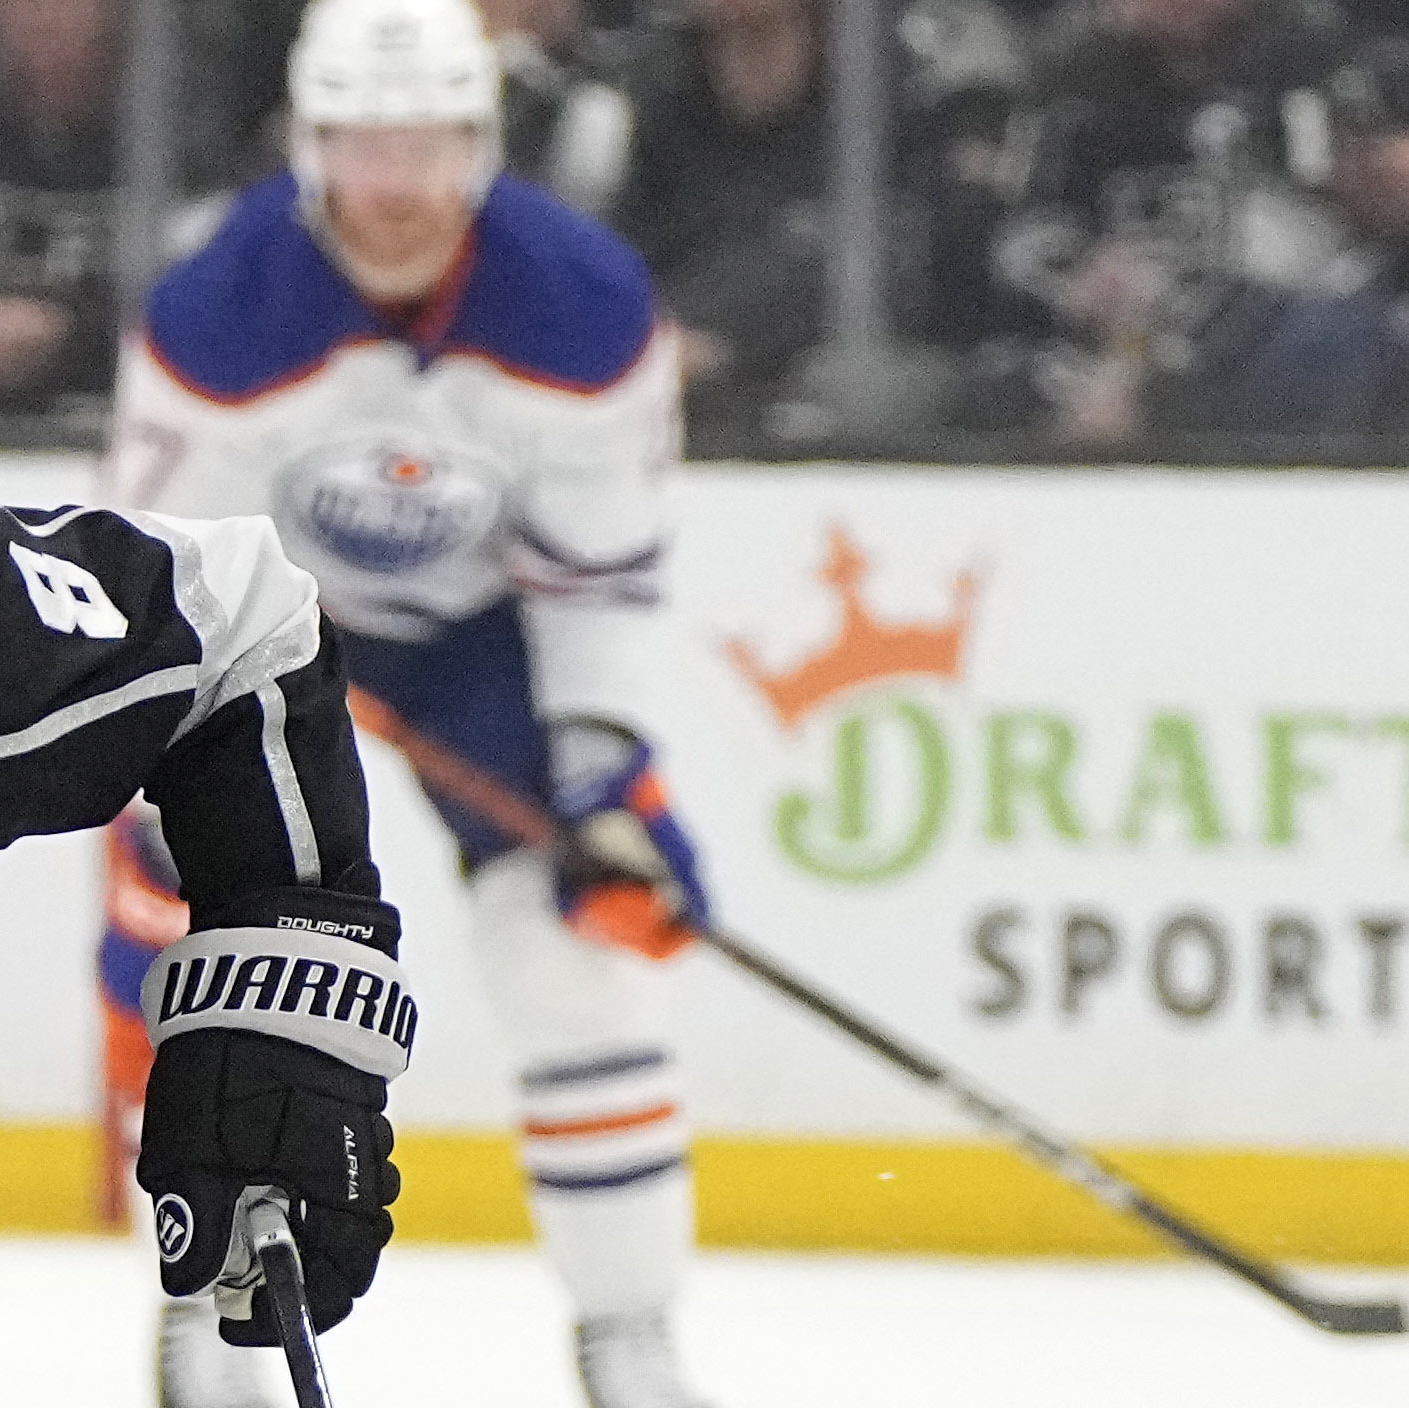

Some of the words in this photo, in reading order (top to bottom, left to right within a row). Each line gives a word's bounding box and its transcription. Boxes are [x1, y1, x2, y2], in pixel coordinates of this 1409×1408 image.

[8, 540, 129, 639] 8
[276, 905, 374, 940] DOUGHTY
[967, 905, 1409, 1022] SPORT
[343, 1124, 360, 1200] ALPHA
